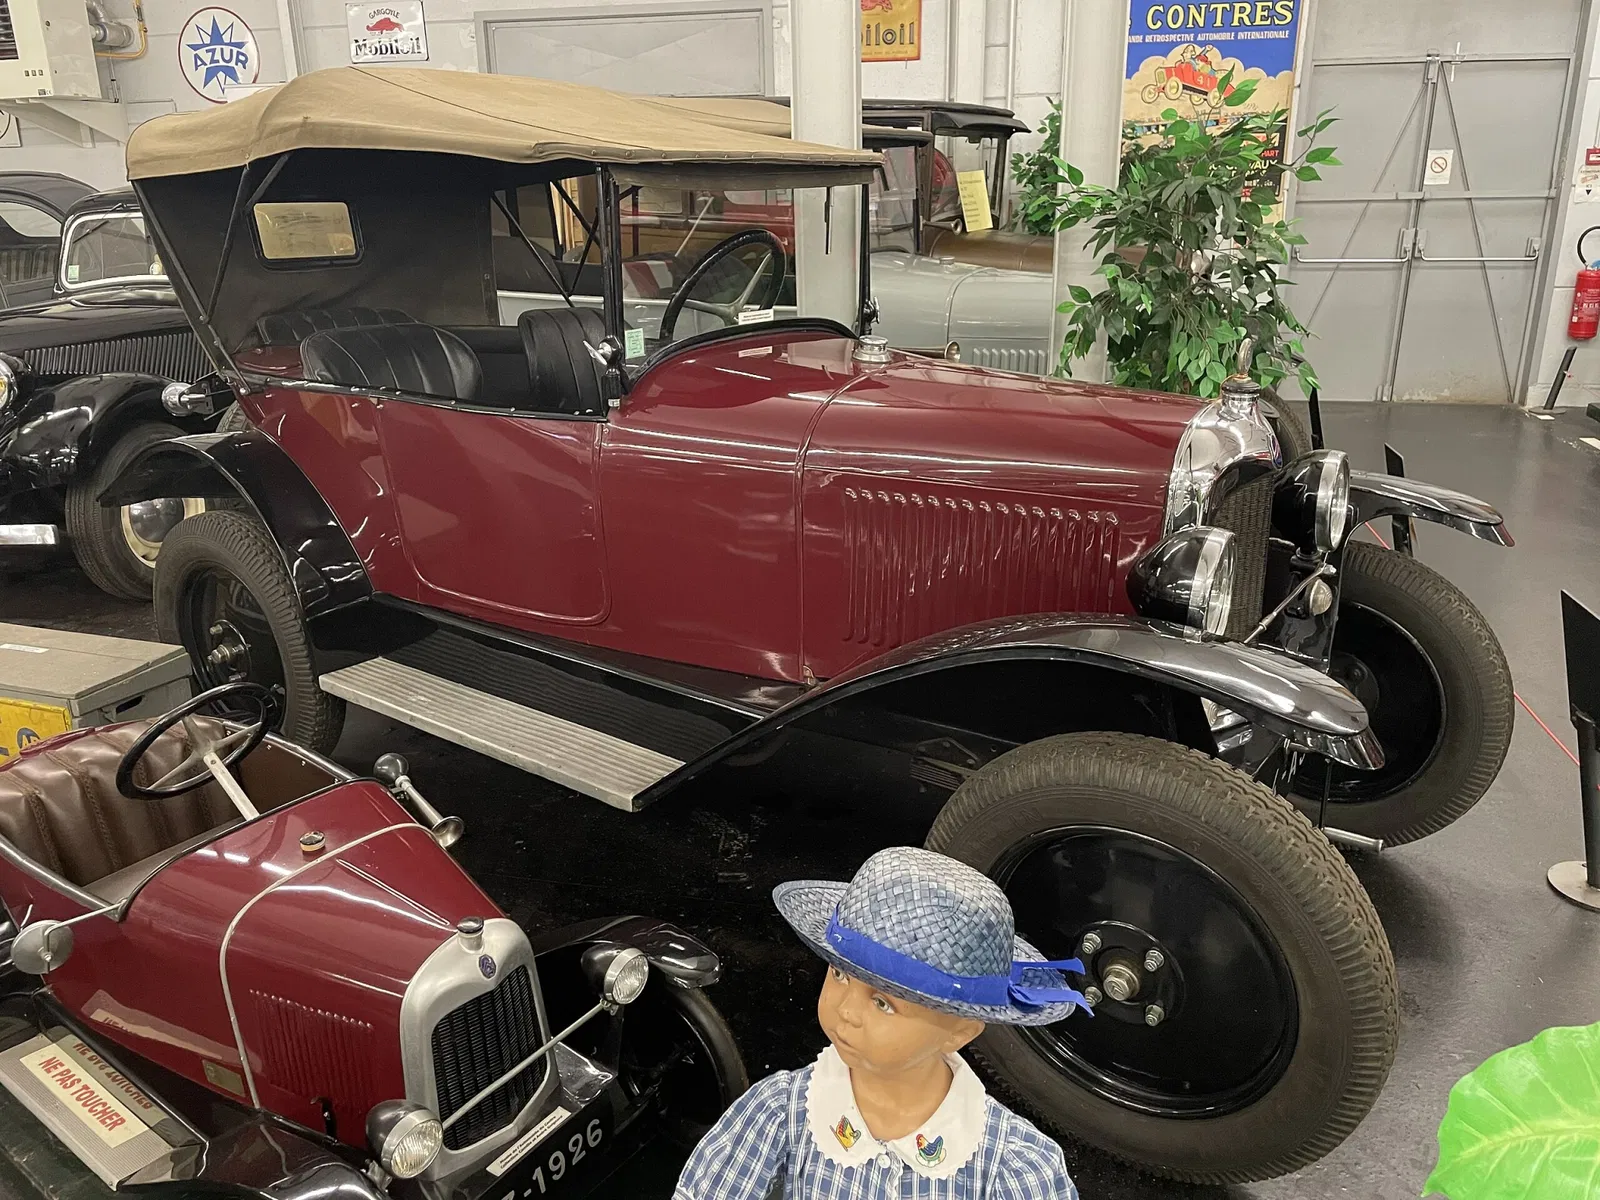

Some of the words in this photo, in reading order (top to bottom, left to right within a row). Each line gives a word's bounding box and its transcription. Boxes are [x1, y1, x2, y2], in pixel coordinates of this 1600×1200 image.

[368, 8, 400, 19] GARGOYLE
[1146, 1, 1293, 30] CONTRES
[861, 22, 914, 46] iloil
[1128, 35, 1143, 43] ANDE
[1145, 33, 1194, 42] RETROSPECTIVE
[1197, 32, 1234, 41] AUTOMOBILE
[1238, 30, 1289, 40] INTERNATIONALE
[354, 37, 422, 56] Mobiloil
[194, 48, 248, 72] AZUR
[38, 1056, 65, 1074] NE
[52, 1068, 82, 1090] PAS
[70, 1084, 126, 1132] TOUCHER
